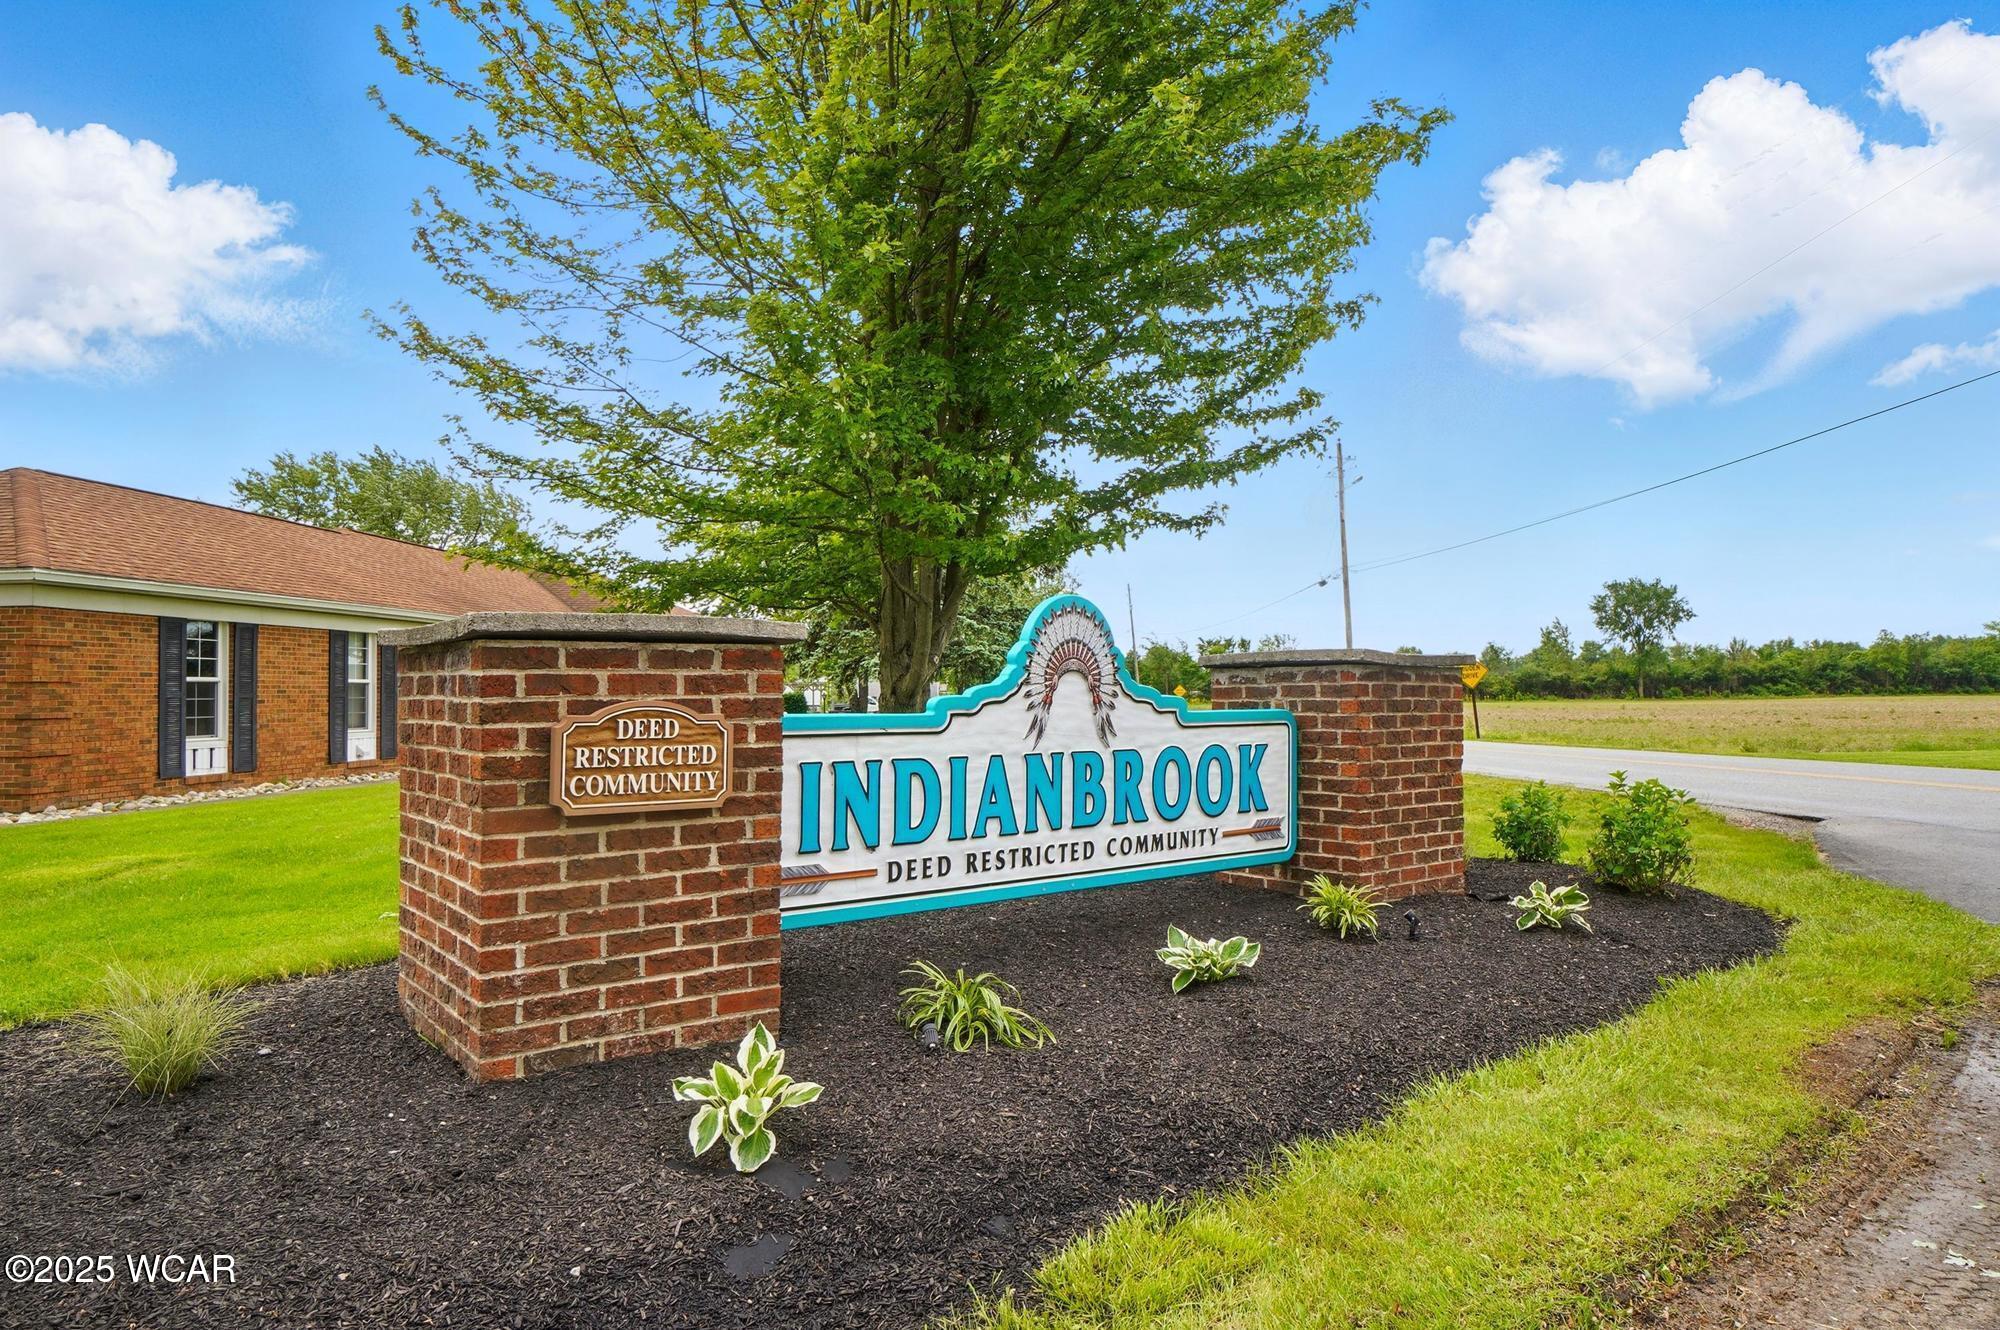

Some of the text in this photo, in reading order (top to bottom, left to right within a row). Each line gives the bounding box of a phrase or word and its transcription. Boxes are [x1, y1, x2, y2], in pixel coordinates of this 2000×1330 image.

[616, 718, 680, 740] DEED
[574, 744, 717, 769] RESTRICTED
[569, 770, 720, 797] COMMUNITY
[798, 743, 1269, 855] INDIANBROOK
[886, 827, 1220, 883] DEED RESTRICTED COMMUNITY
